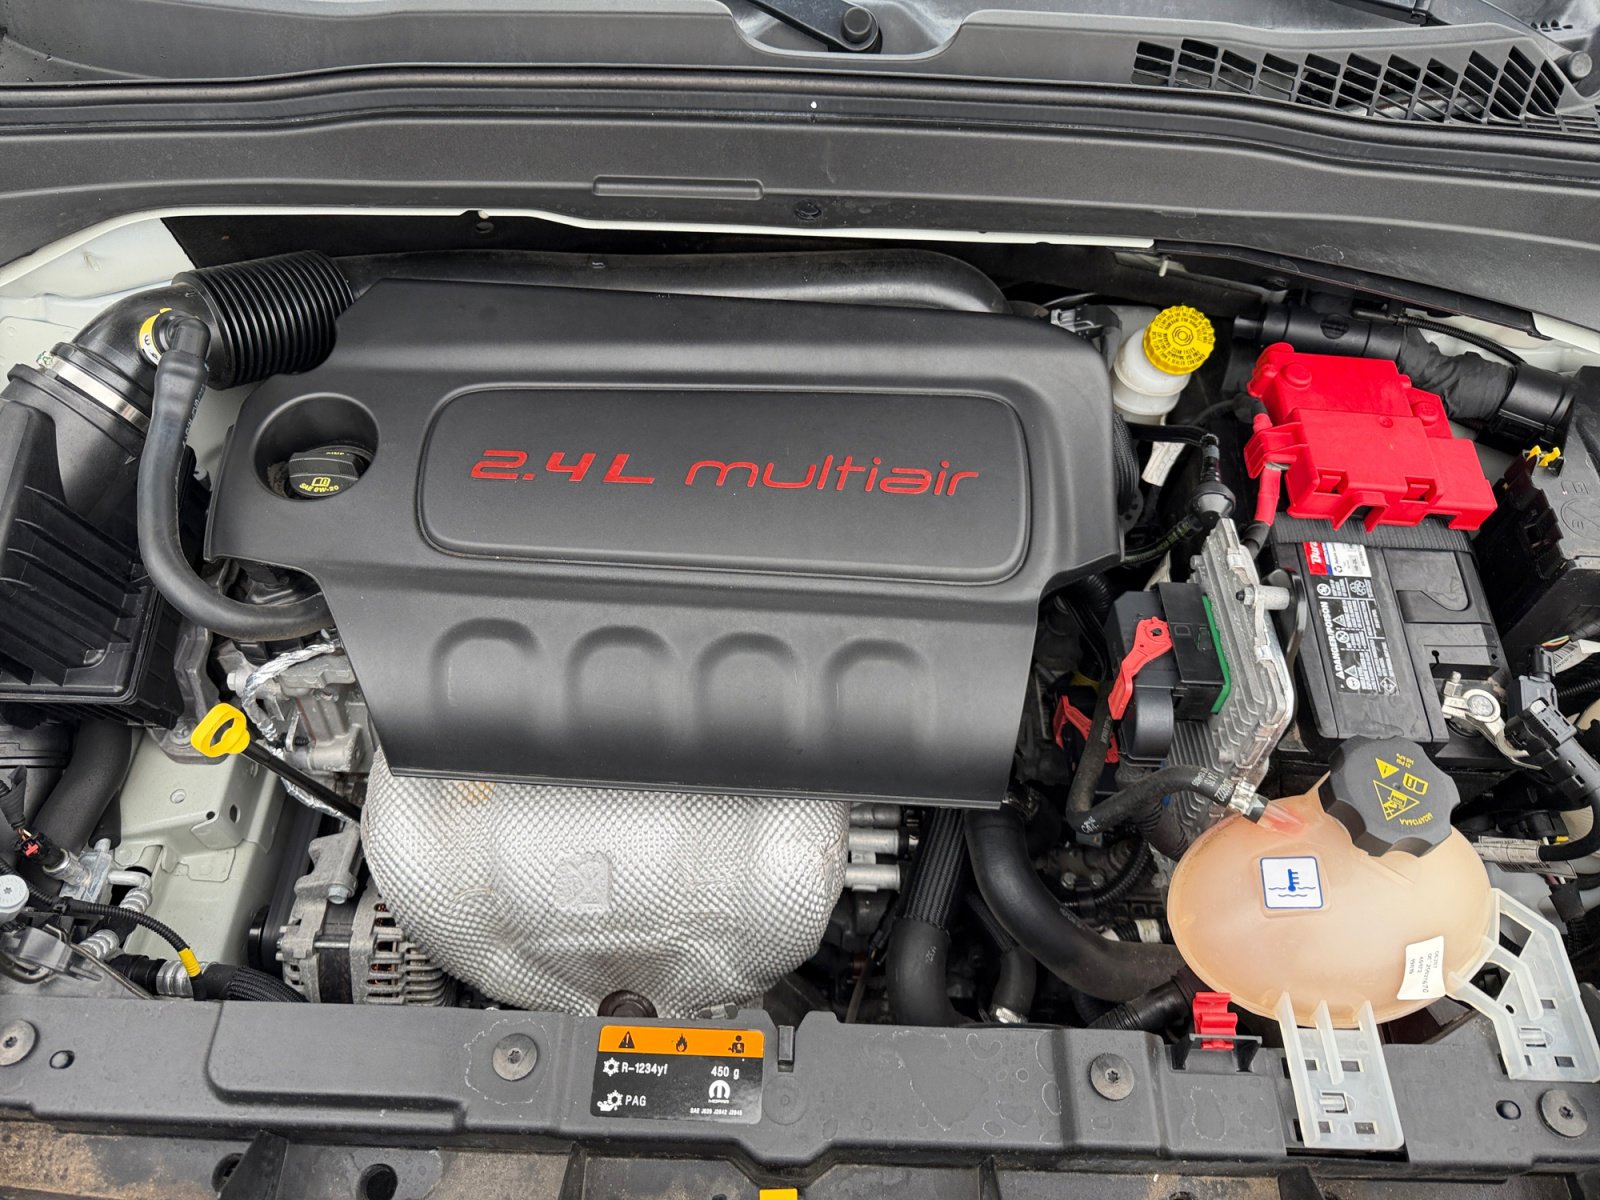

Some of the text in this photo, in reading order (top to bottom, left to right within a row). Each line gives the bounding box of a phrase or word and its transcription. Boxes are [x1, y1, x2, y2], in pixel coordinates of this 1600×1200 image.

[684, 453, 980, 496] multiair
[1320, 601, 1343, 671] DANGER/POISON
[621, 1062, 740, 1080] R-1234yf 450 g
[625, 1094, 647, 1107] PAG
